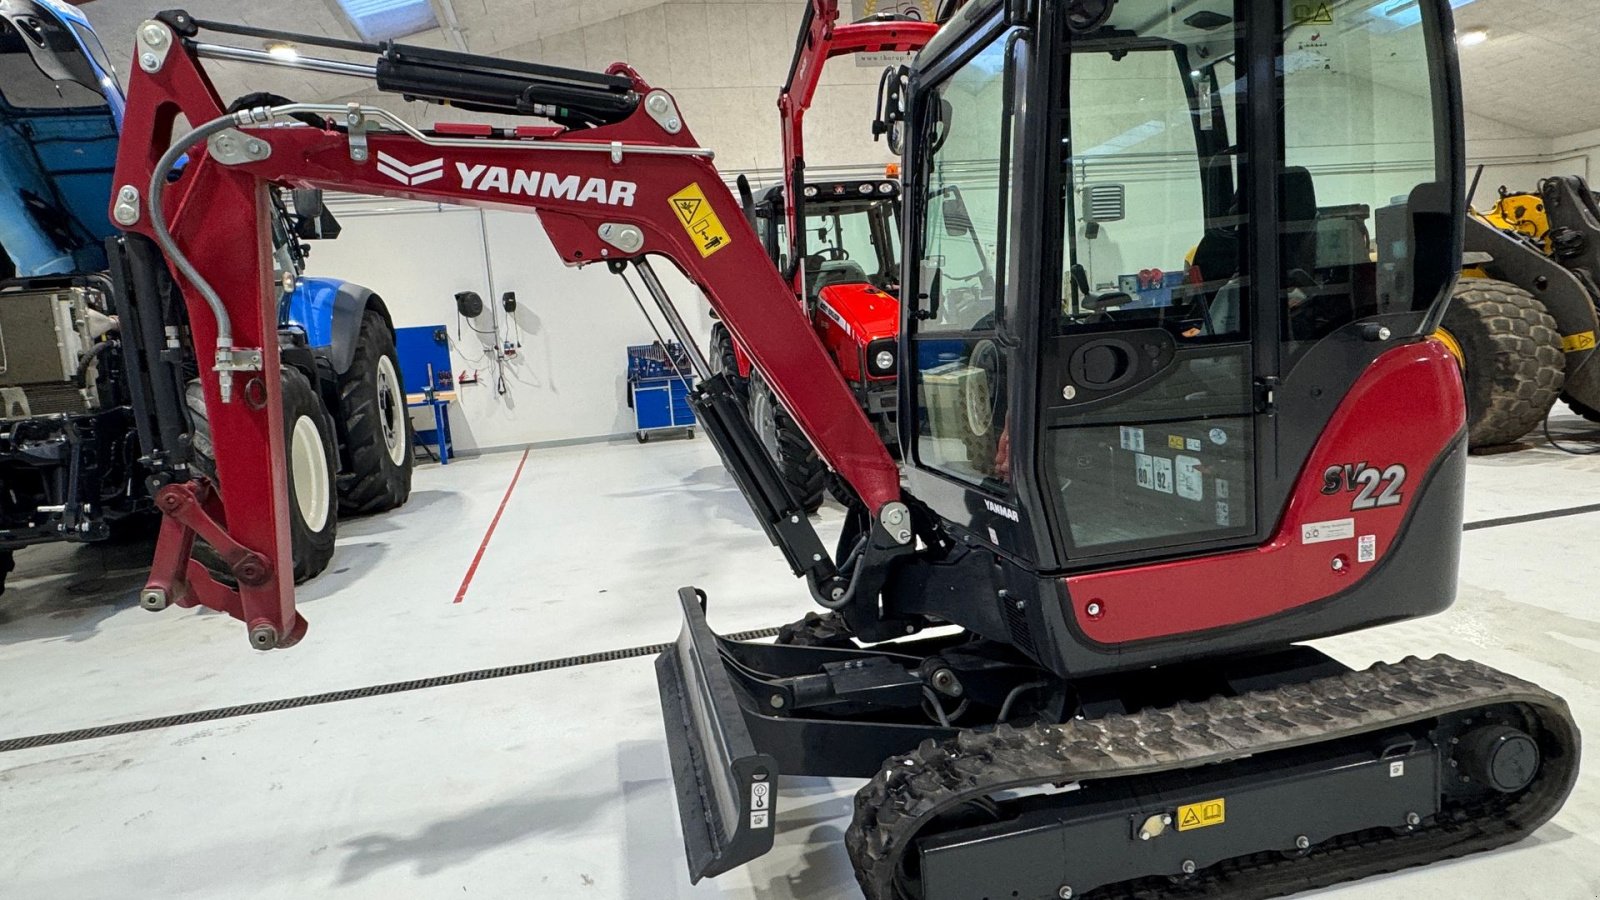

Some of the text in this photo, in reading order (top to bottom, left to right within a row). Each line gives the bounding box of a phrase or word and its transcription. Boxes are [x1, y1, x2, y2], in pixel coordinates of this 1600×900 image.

[455, 161, 637, 207] YANMAR
[1321, 461, 1407, 512] SV22
[984, 499, 1019, 523] YANMAR
